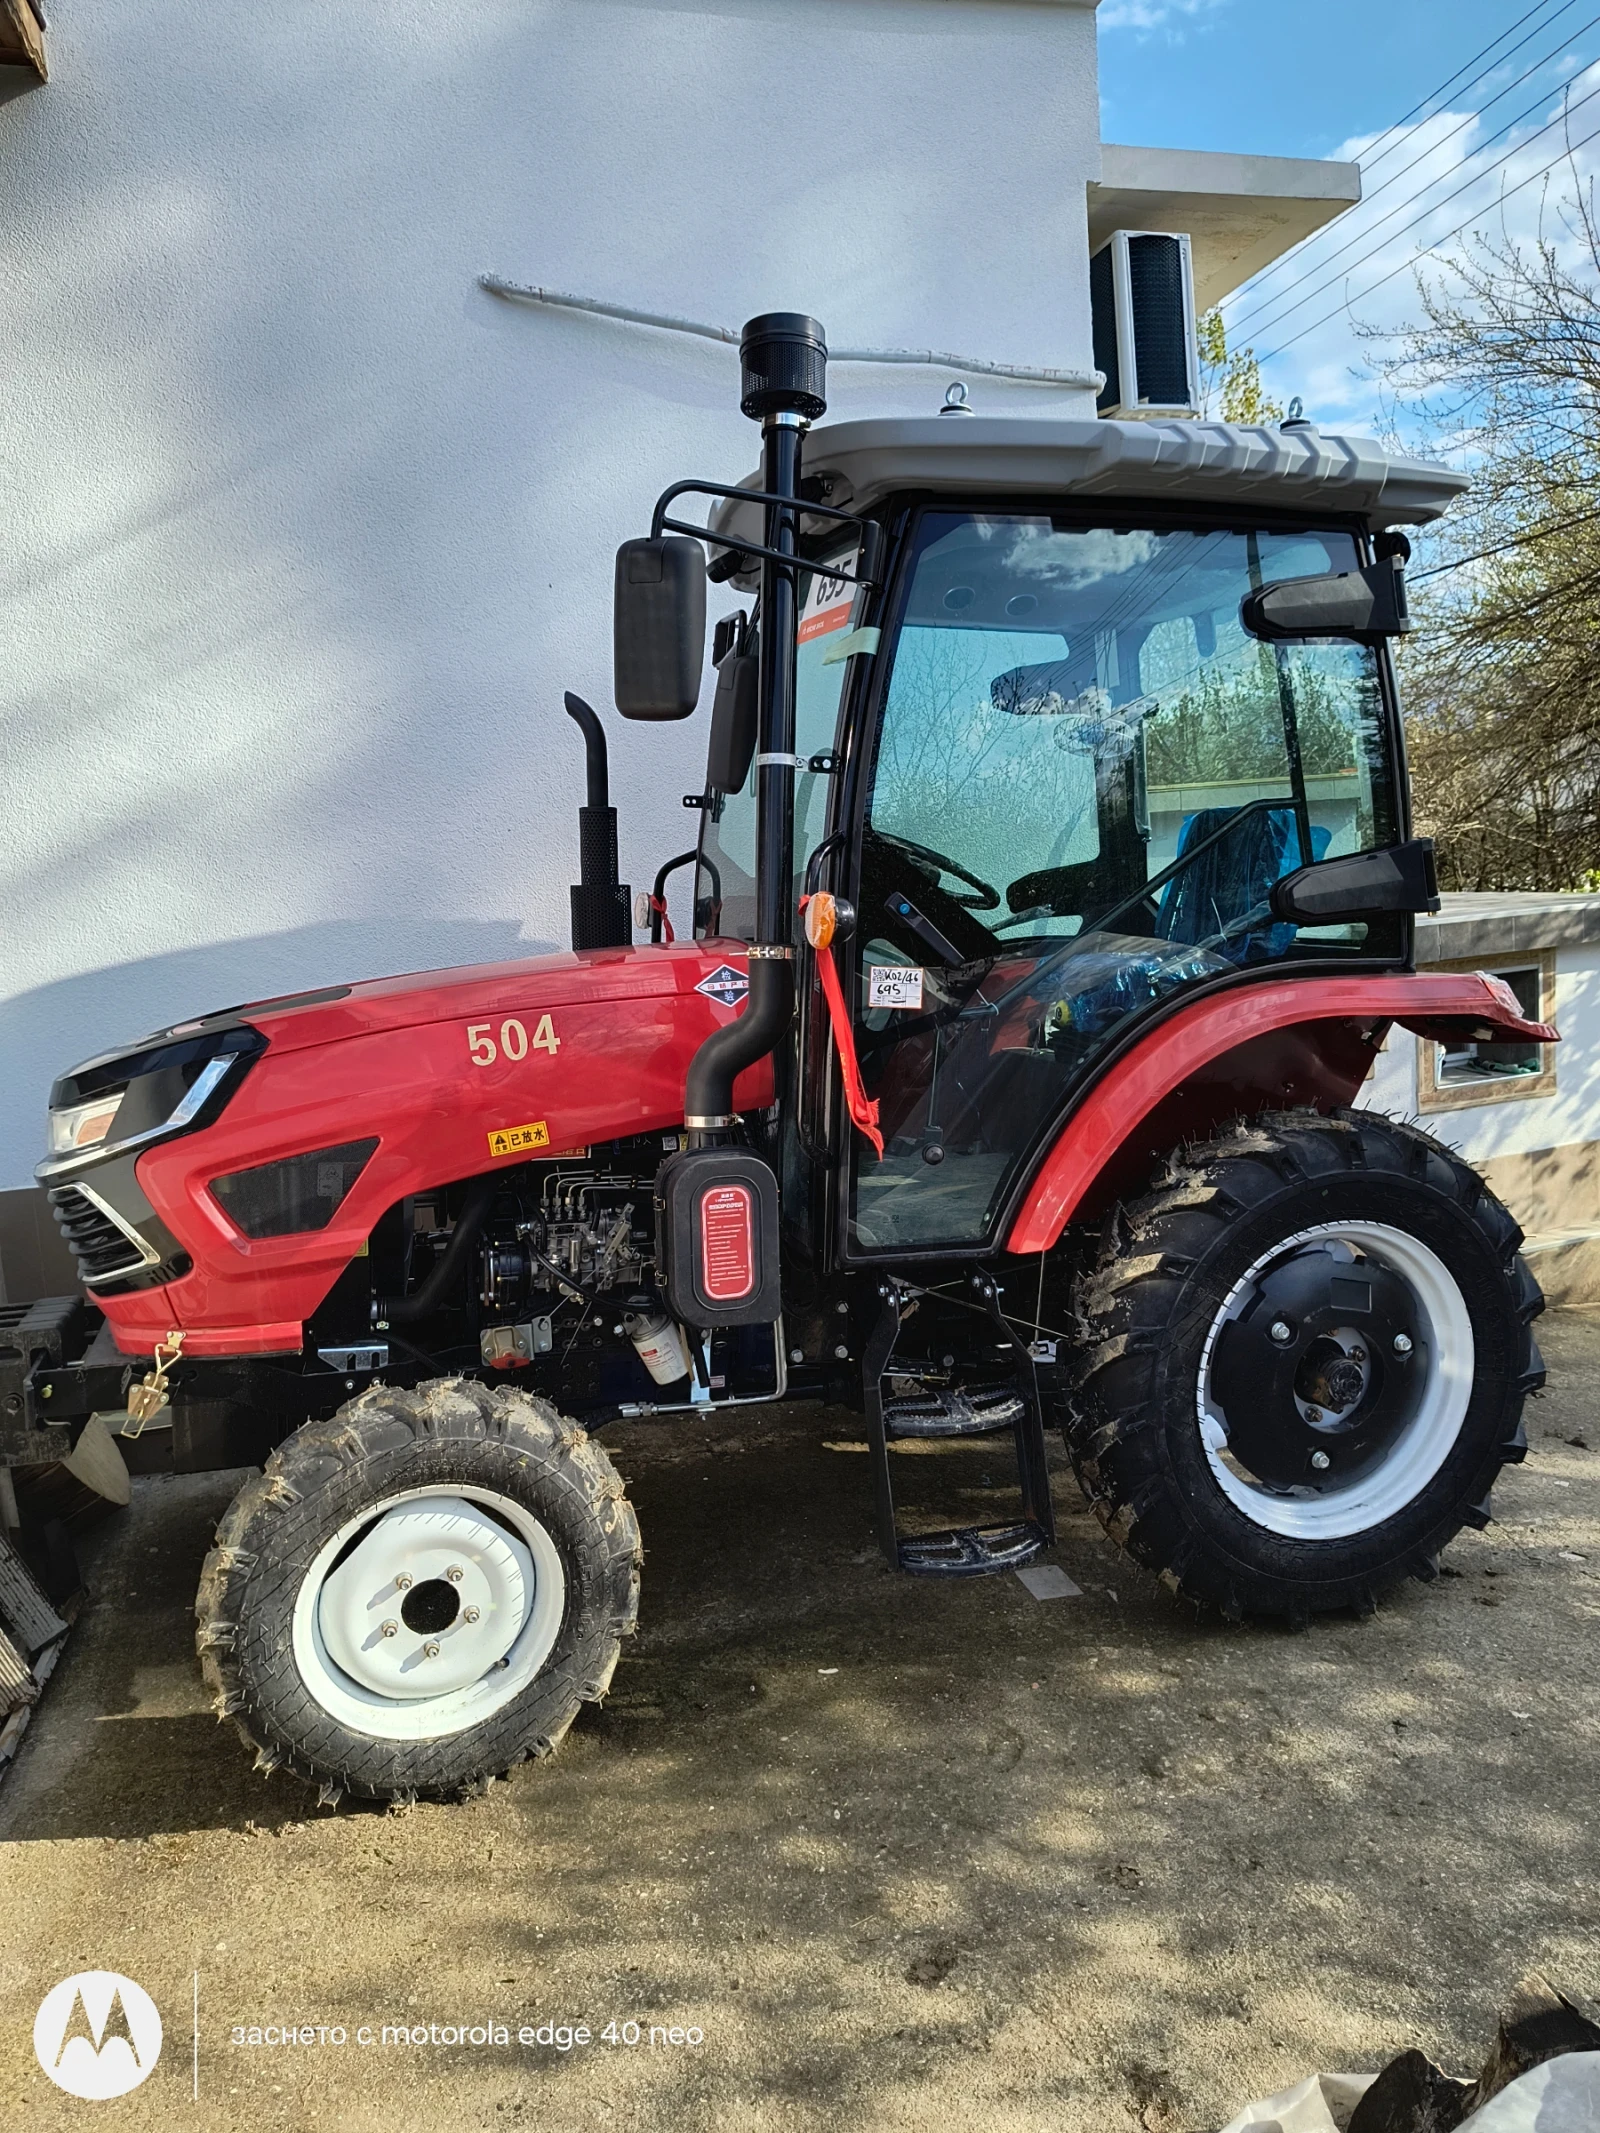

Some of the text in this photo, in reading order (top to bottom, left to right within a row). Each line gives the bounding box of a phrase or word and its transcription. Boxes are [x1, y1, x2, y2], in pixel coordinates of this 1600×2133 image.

[816, 559, 853, 607] 695
[877, 983, 901, 995] 695
[467, 1014, 561, 1067] 504
[510, 1128, 545, 1147] 已放水
